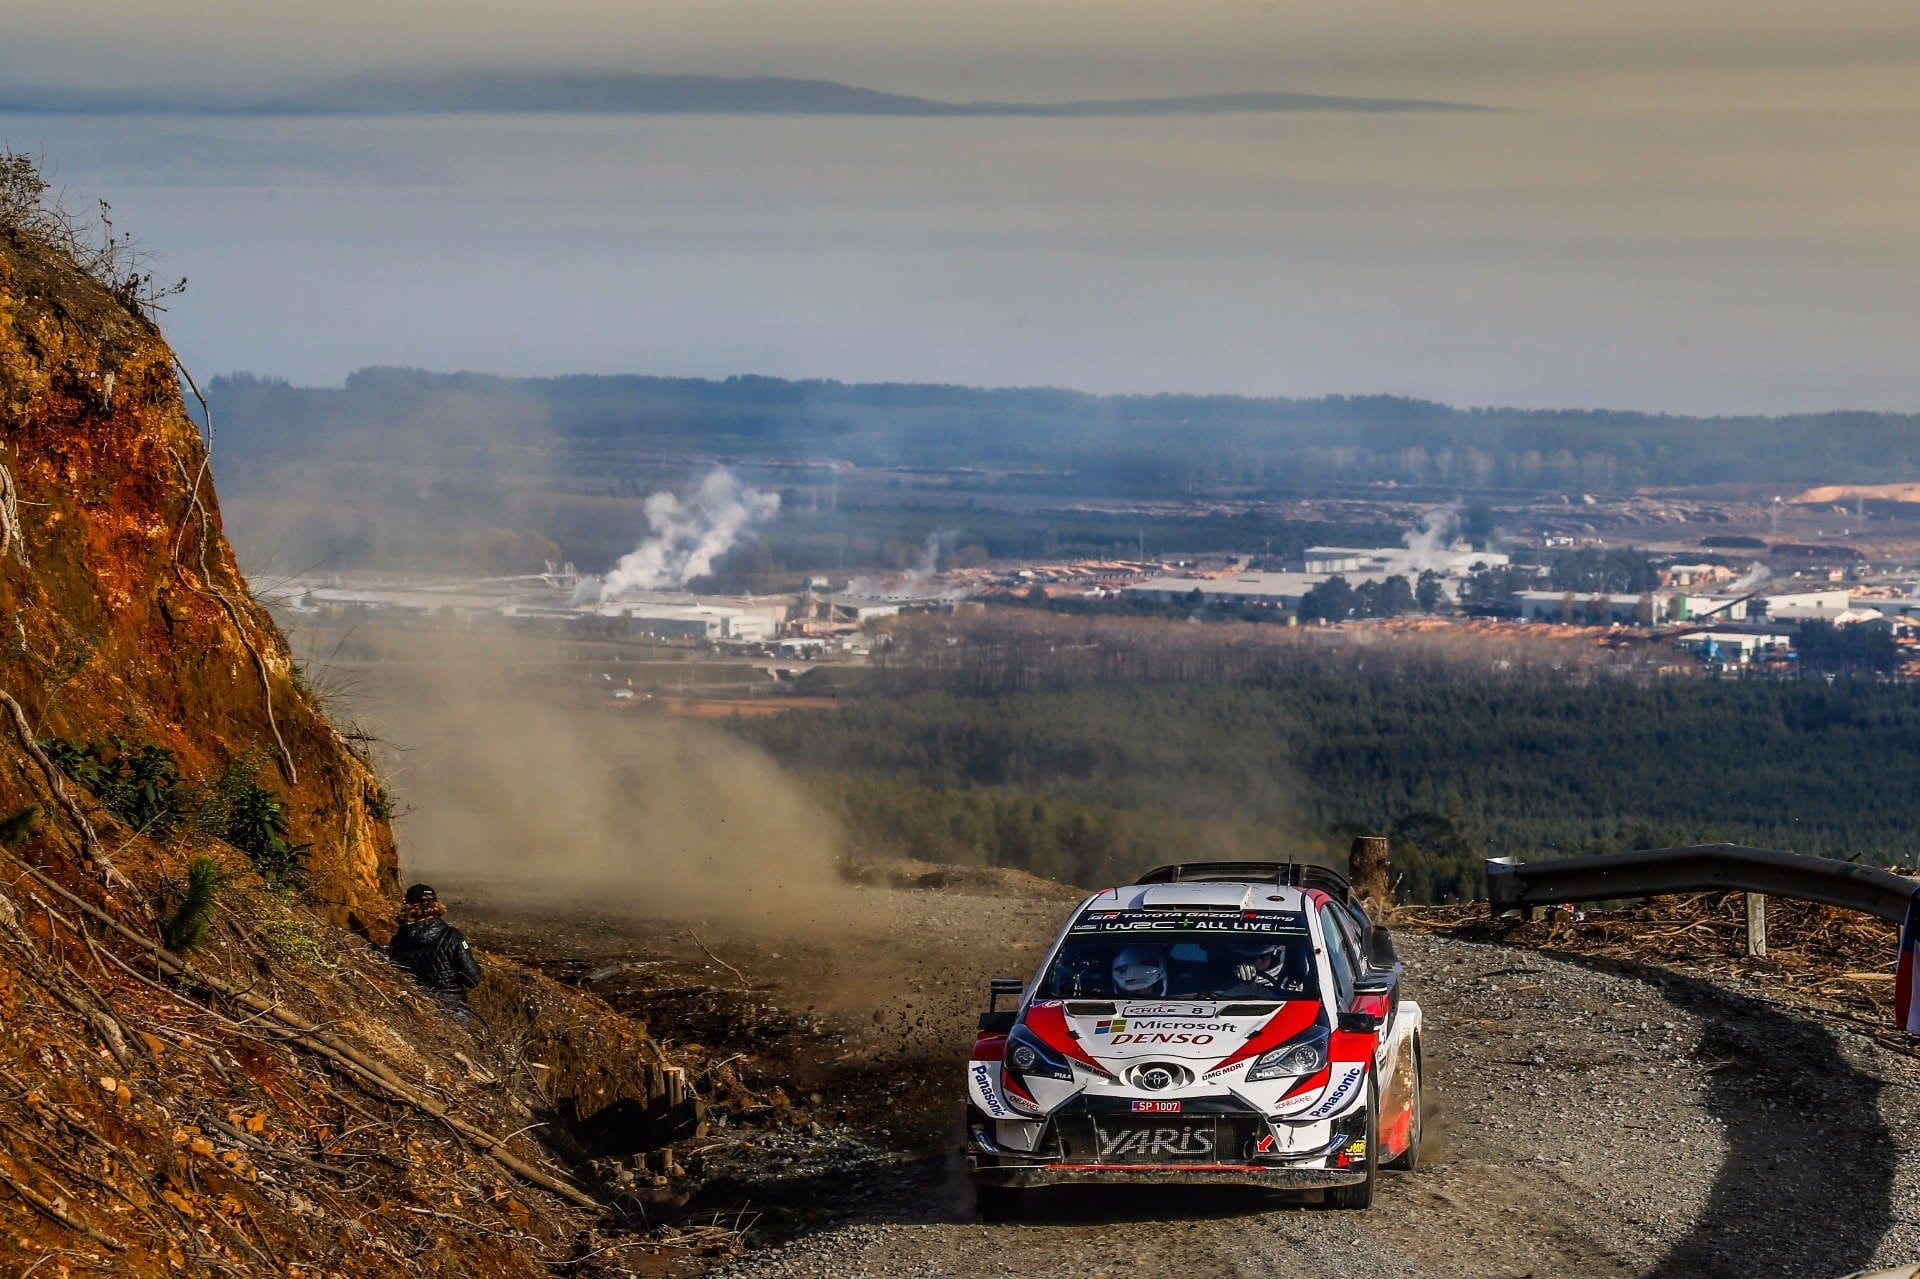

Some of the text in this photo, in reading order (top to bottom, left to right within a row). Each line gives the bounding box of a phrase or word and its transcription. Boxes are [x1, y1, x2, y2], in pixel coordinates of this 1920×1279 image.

[1243, 913, 1295, 922] Racing
[1195, 921, 1228, 930] ALL
[1233, 922, 1272, 931] LIVE
[1191, 1007, 1204, 1015] 8
[1133, 1020, 1237, 1033] Microsoft
[1110, 1033, 1214, 1046] DENSO
[1074, 1061, 1093, 1073] DMG
[1201, 1062, 1244, 1081] DMG MORI
[972, 1064, 1006, 1118] Panasonic
[1308, 1067, 1361, 1118] Panasonic
[1139, 1102, 1178, 1111] SP 1007
